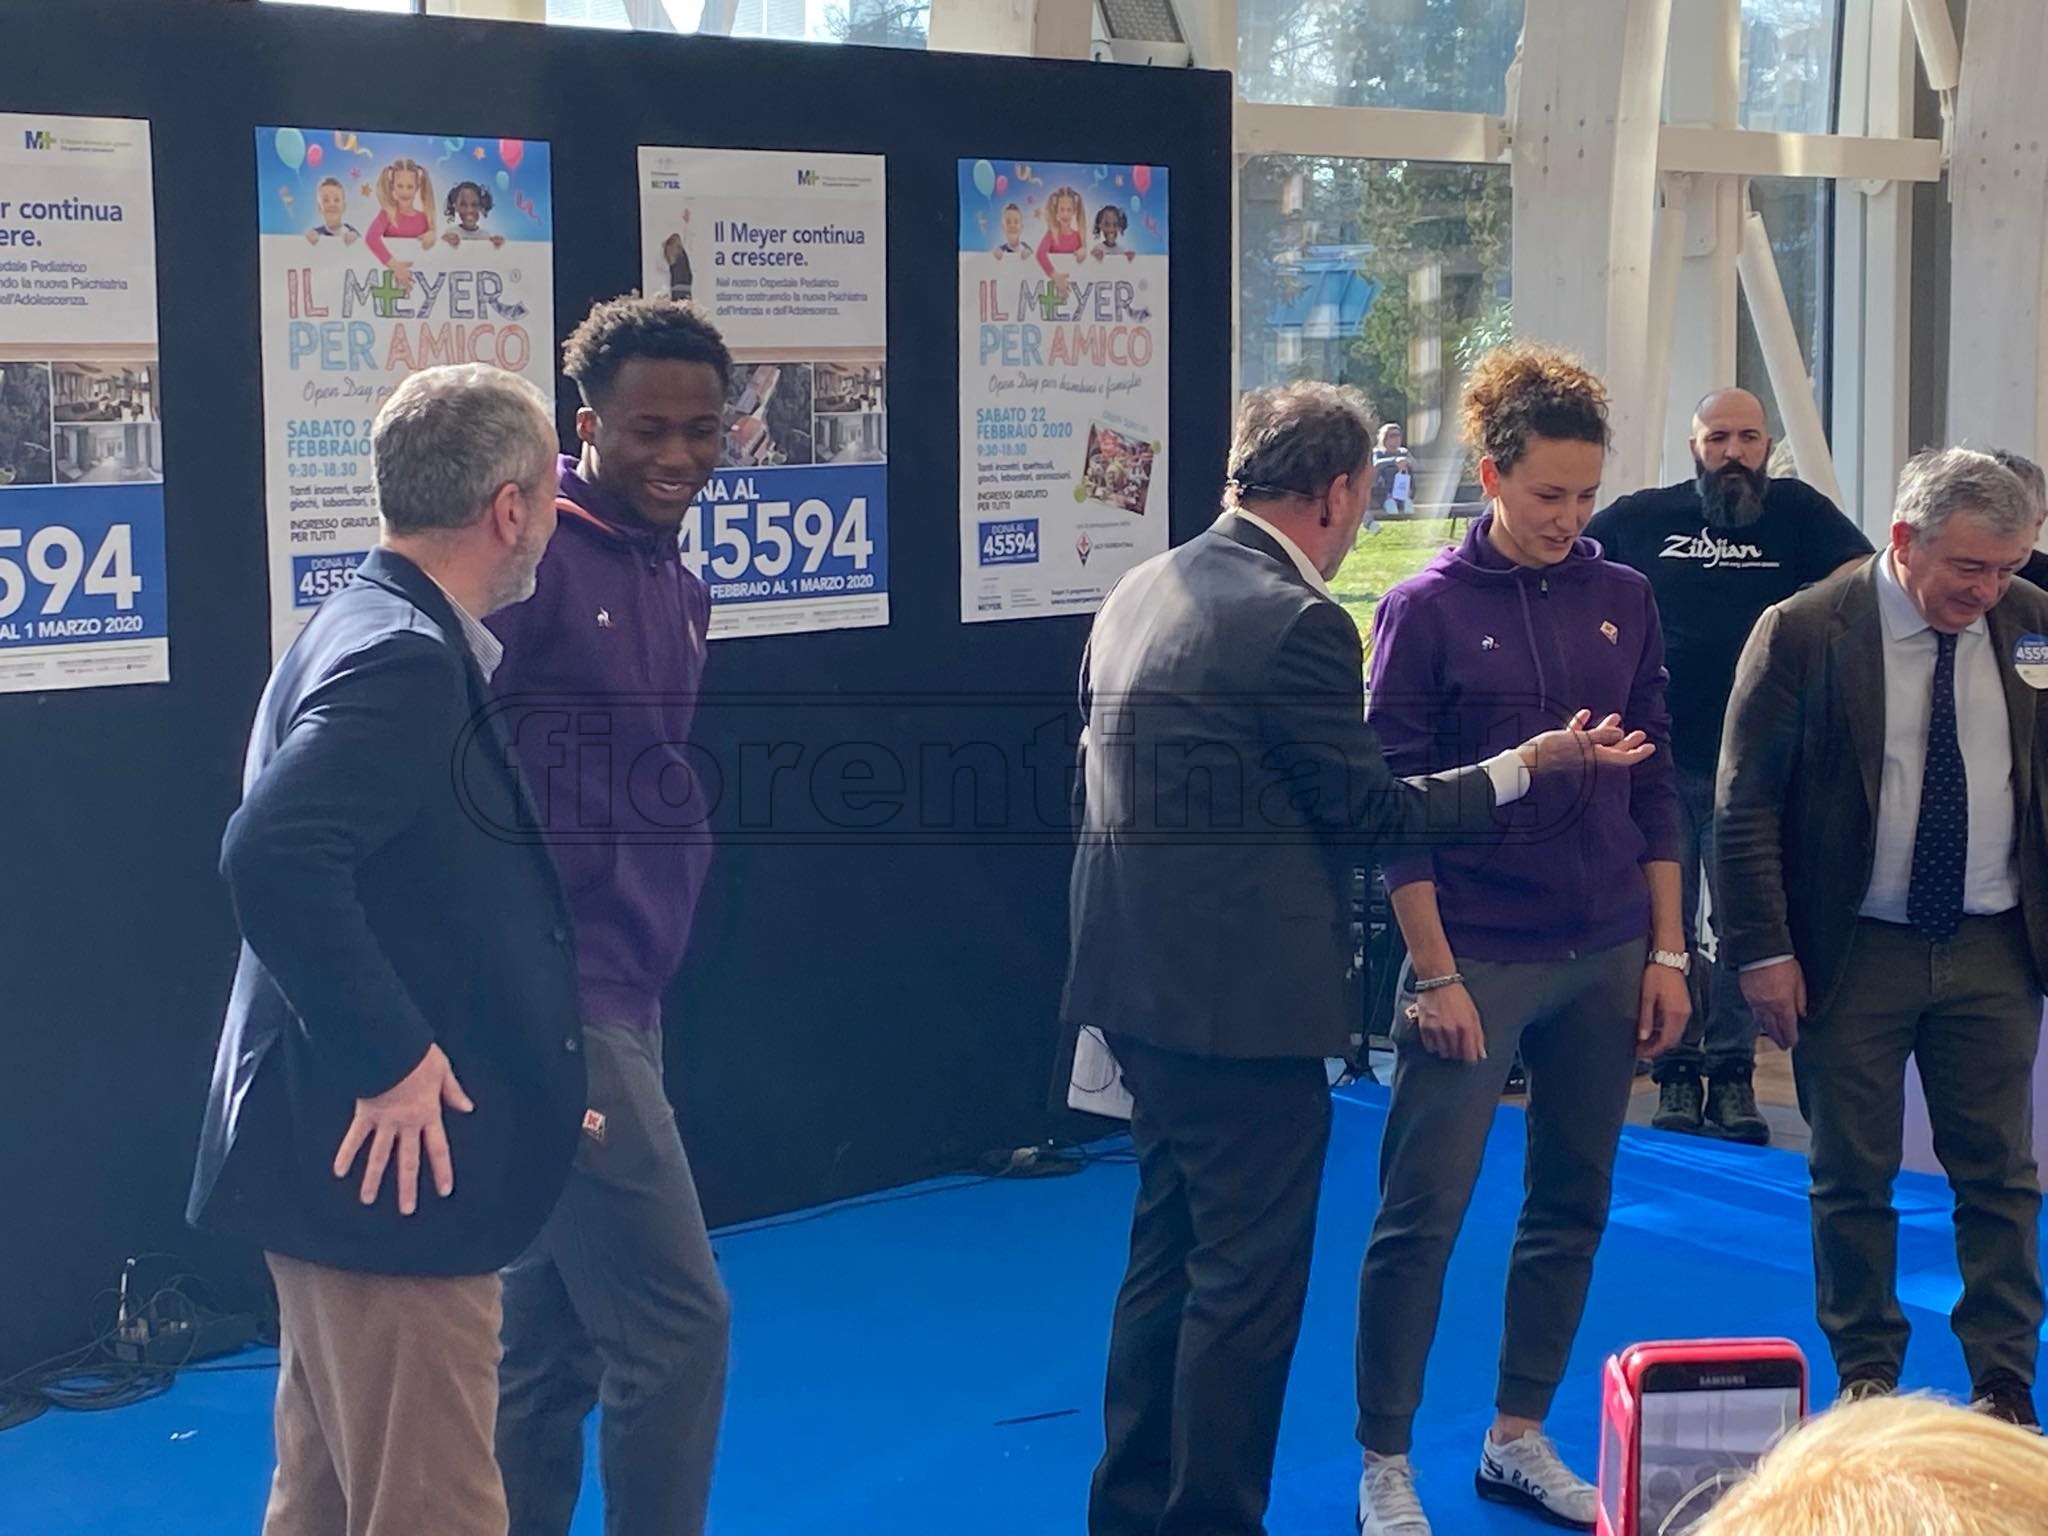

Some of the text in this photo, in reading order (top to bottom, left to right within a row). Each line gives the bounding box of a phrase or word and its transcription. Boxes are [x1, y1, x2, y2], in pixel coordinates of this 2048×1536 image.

[20, 197, 123, 221] continua
[714, 221, 865, 249] Il Meyer continua
[31, 260, 87, 273] Pediatrico
[715, 250, 808, 266] a crescere.
[21, 277, 31, 289] la
[34, 279, 68, 290] nuova
[71, 277, 128, 290] Psichiatria
[287, 268, 329, 319] IL
[716, 277, 839, 290] Nel nostro Ospedale Pediatrico
[979, 280, 1009, 322] IL
[289, 321, 531, 372] PER AMICO
[979, 324, 1153, 367] PER AMICO
[303, 380, 339, 407] Open
[342, 376, 372, 403] Day
[989, 373, 1014, 398] Open
[1018, 371, 1039, 391] Day
[976, 407, 1046, 424] SABATO 22
[287, 420, 374, 438] SABATO 2
[976, 422, 1072, 439] FEBBRAIO 2020
[287, 439, 372, 458] FEBBRAIO
[697, 478, 760, 502] NA AL
[977, 489, 1048, 501] INGRESSO GRATUITO
[977, 501, 1010, 511] PER TUTTI
[290, 516, 379, 530] INGRESSO GRATUIT
[290, 530, 336, 542] PER TUTTI
[678, 498, 873, 579] 45594
[983, 531, 1036, 556] 45594
[1659, 526, 1762, 568] Zildjian
[311, 557, 358, 570] DONA AL
[710, 574, 874, 599] FEBBRAIO AL 1 MARZO 2020
[0, 615, 143, 640] AL 1 MARZO 2020
[1699, 1375, 1746, 1386] SAMSUNG
[1511, 1469, 1548, 1500] RACE
